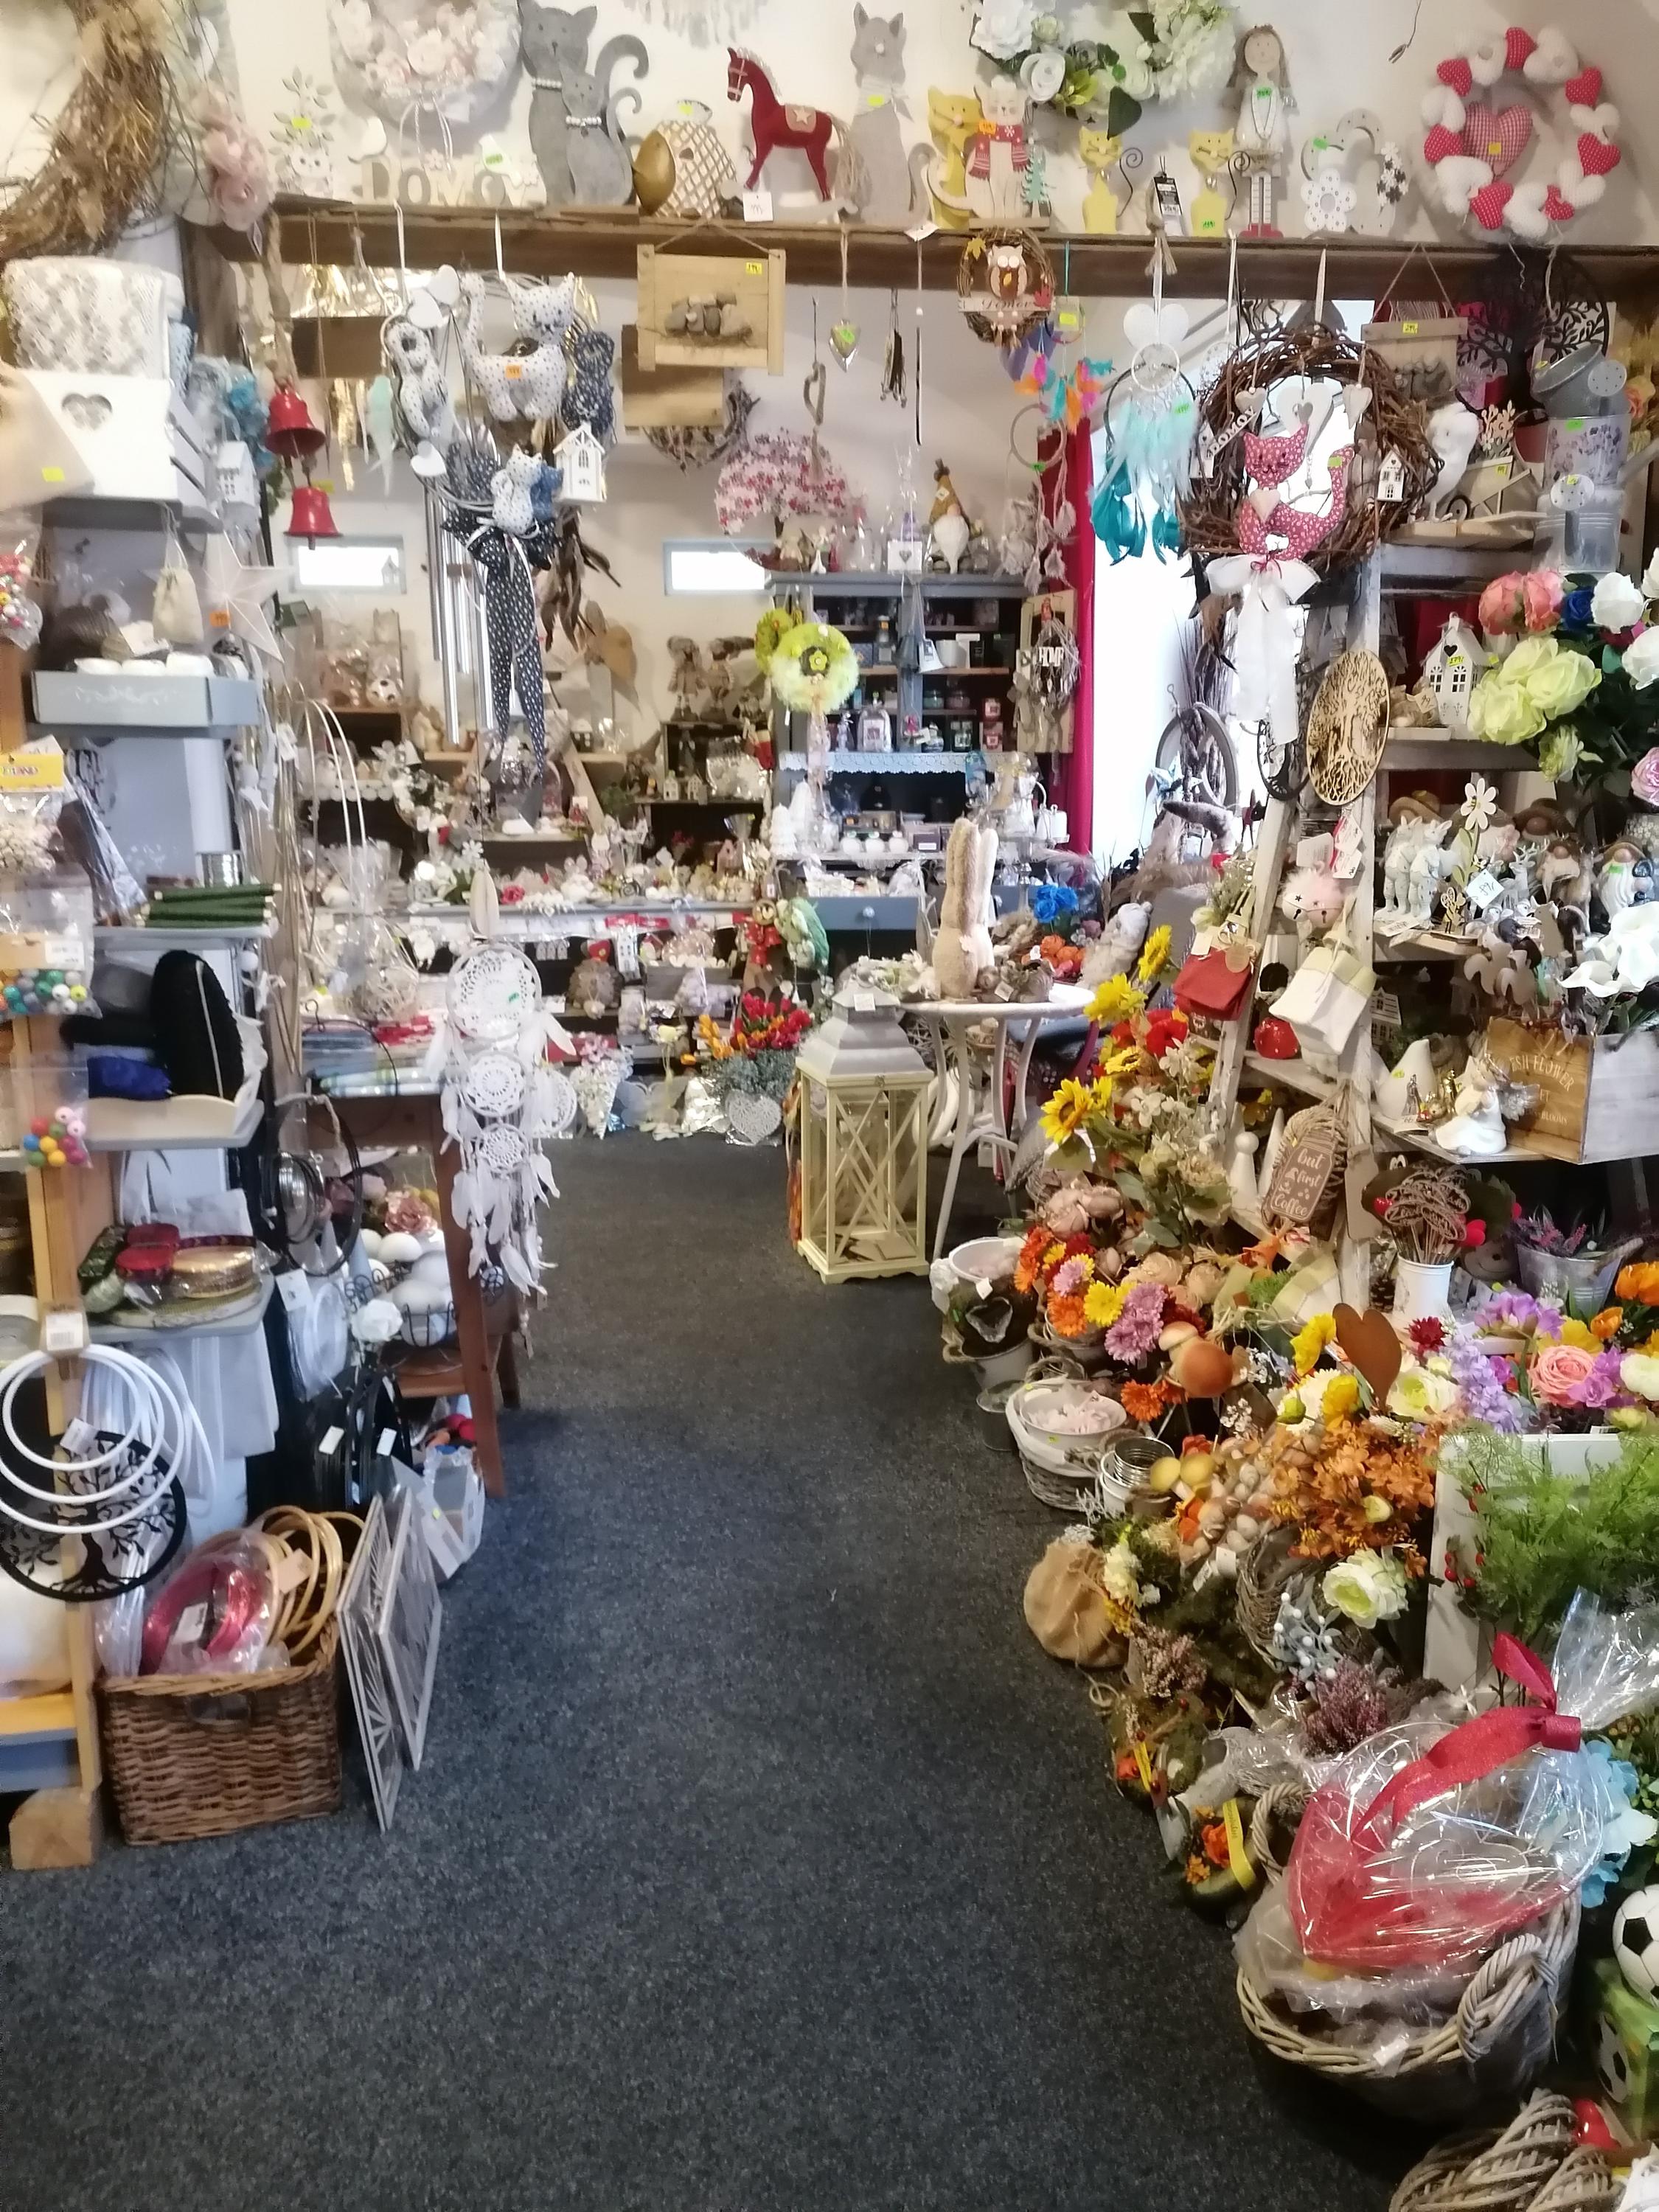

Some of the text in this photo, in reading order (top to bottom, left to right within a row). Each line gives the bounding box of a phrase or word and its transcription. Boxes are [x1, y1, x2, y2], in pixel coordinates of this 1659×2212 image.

[1533, 1054, 1575, 1092] FLOWER
[1298, 1147, 1326, 1169] but
[1297, 1169, 1324, 1188] first
[1274, 1193, 1308, 1217] Coffee
